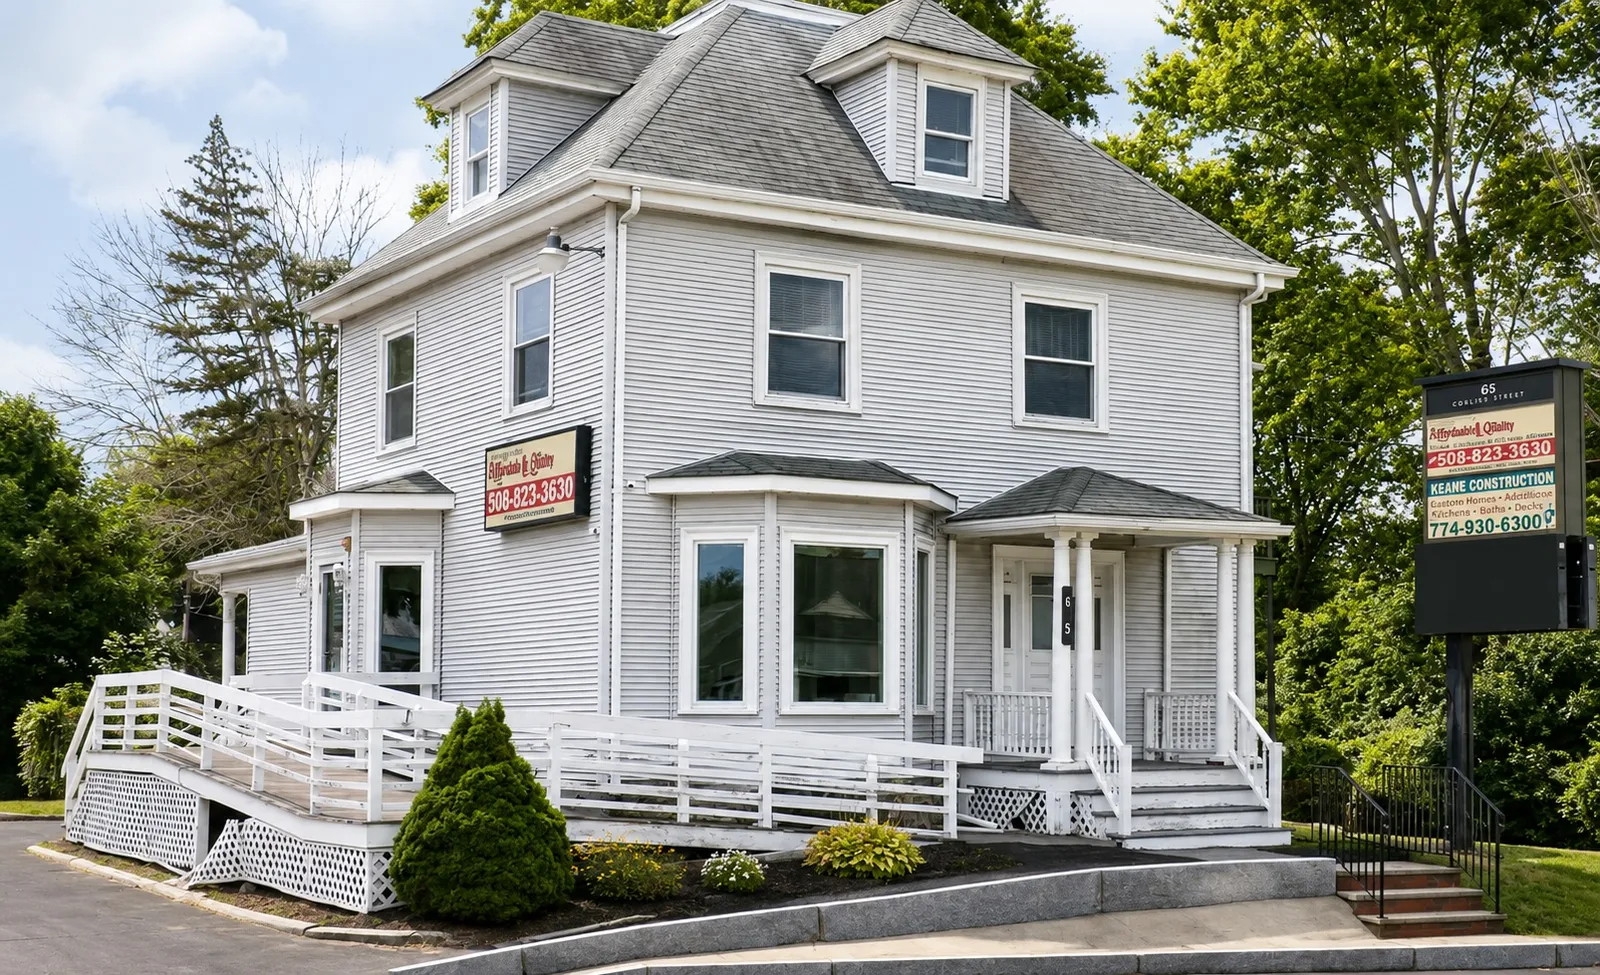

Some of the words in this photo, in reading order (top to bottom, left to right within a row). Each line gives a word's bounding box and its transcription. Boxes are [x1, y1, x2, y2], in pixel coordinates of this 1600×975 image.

[1480, 382, 1496, 395] 65
[1437, 440, 1551, 467] 508-823-3630
[1430, 480, 1466, 495] KEANE
[1469, 470, 1554, 491] CONSTRUCTION
[1466, 495, 1497, 505] Homes
[1430, 513, 1542, 538] 774-930-6300
